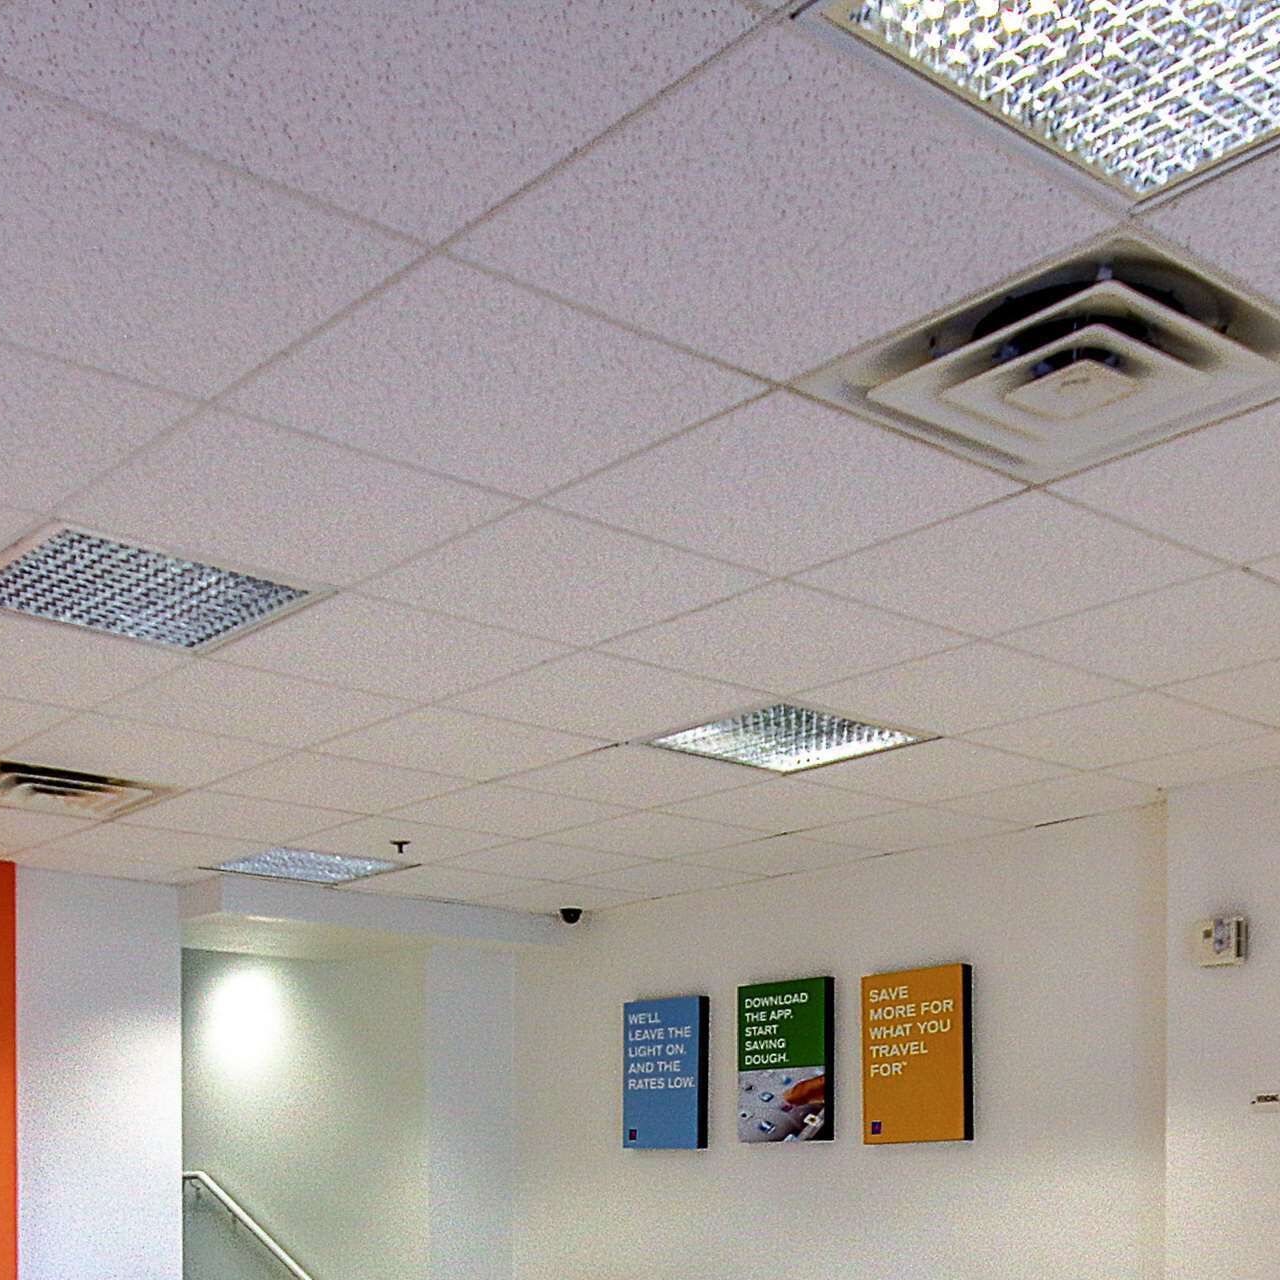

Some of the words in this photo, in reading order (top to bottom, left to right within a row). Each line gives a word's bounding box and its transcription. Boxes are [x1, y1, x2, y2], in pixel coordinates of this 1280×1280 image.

[745, 992, 808, 1009] DOWNLOAD
[869, 986, 909, 1003] SAVE
[745, 1011, 767, 1022] THE
[770, 1009, 793, 1020] APP.
[870, 1004, 916, 1020] MORE
[921, 999, 953, 1015] FOR
[628, 1012, 661, 1024] WE'LL
[628, 1028, 664, 1041] LEAVE
[668, 1026, 692, 1038] THE
[745, 1025, 778, 1037] START
[869, 1023, 913, 1040] WHAT
[917, 1018, 951, 1034] YOU
[628, 1045, 663, 1057] LIGHT
[666, 1044, 687, 1055] ON.
[745, 1038, 786, 1051] SAVING
[869, 1041, 928, 1058] TRAVEL
[745, 1053, 790, 1065] DOUGH.
[628, 1062, 654, 1073] AND
[657, 1060, 681, 1072] THE
[628, 1077, 665, 1090] RATES
